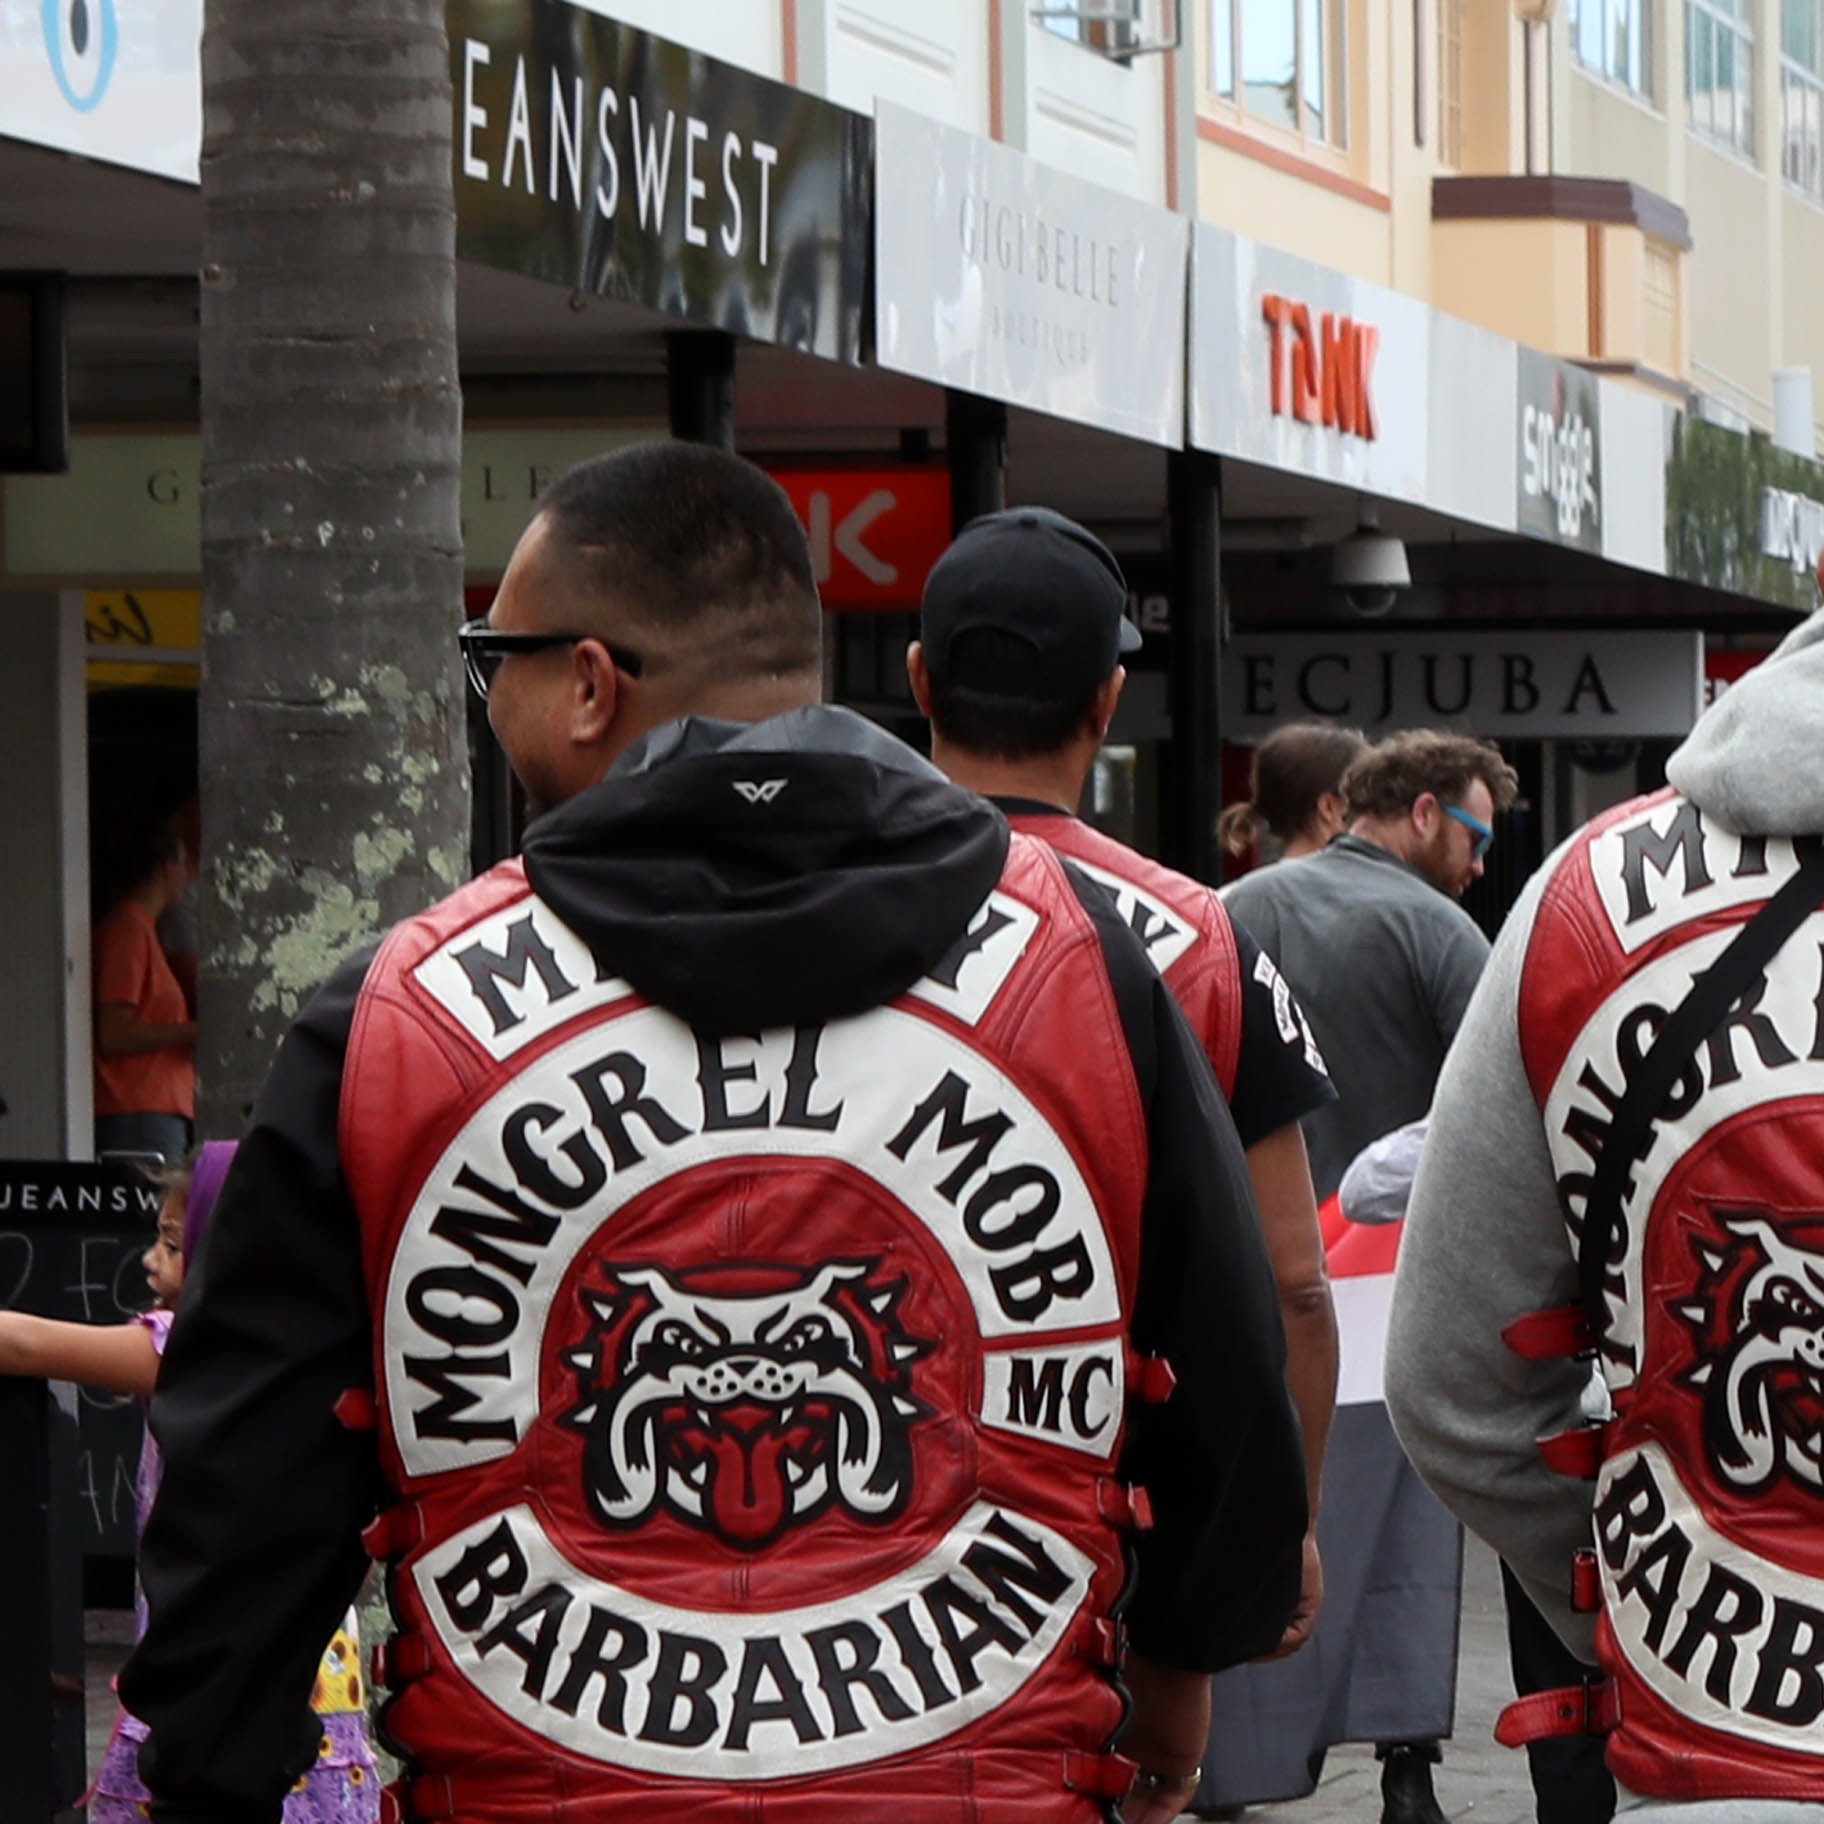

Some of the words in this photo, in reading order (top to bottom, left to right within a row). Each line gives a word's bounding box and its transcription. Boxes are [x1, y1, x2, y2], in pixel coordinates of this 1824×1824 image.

[462, 38, 779, 266] EANSWEST
[1037, 221, 1118, 308] BELLE
[1262, 293, 1378, 441] TANK
[1241, 650, 1618, 722] ECJUBA
[403, 1024, 846, 1446] MONGREL
[885, 1067, 1096, 1323] MOB
[1006, 1356, 1115, 1438] MC
[433, 1508, 1077, 1753] BARBARIAN
